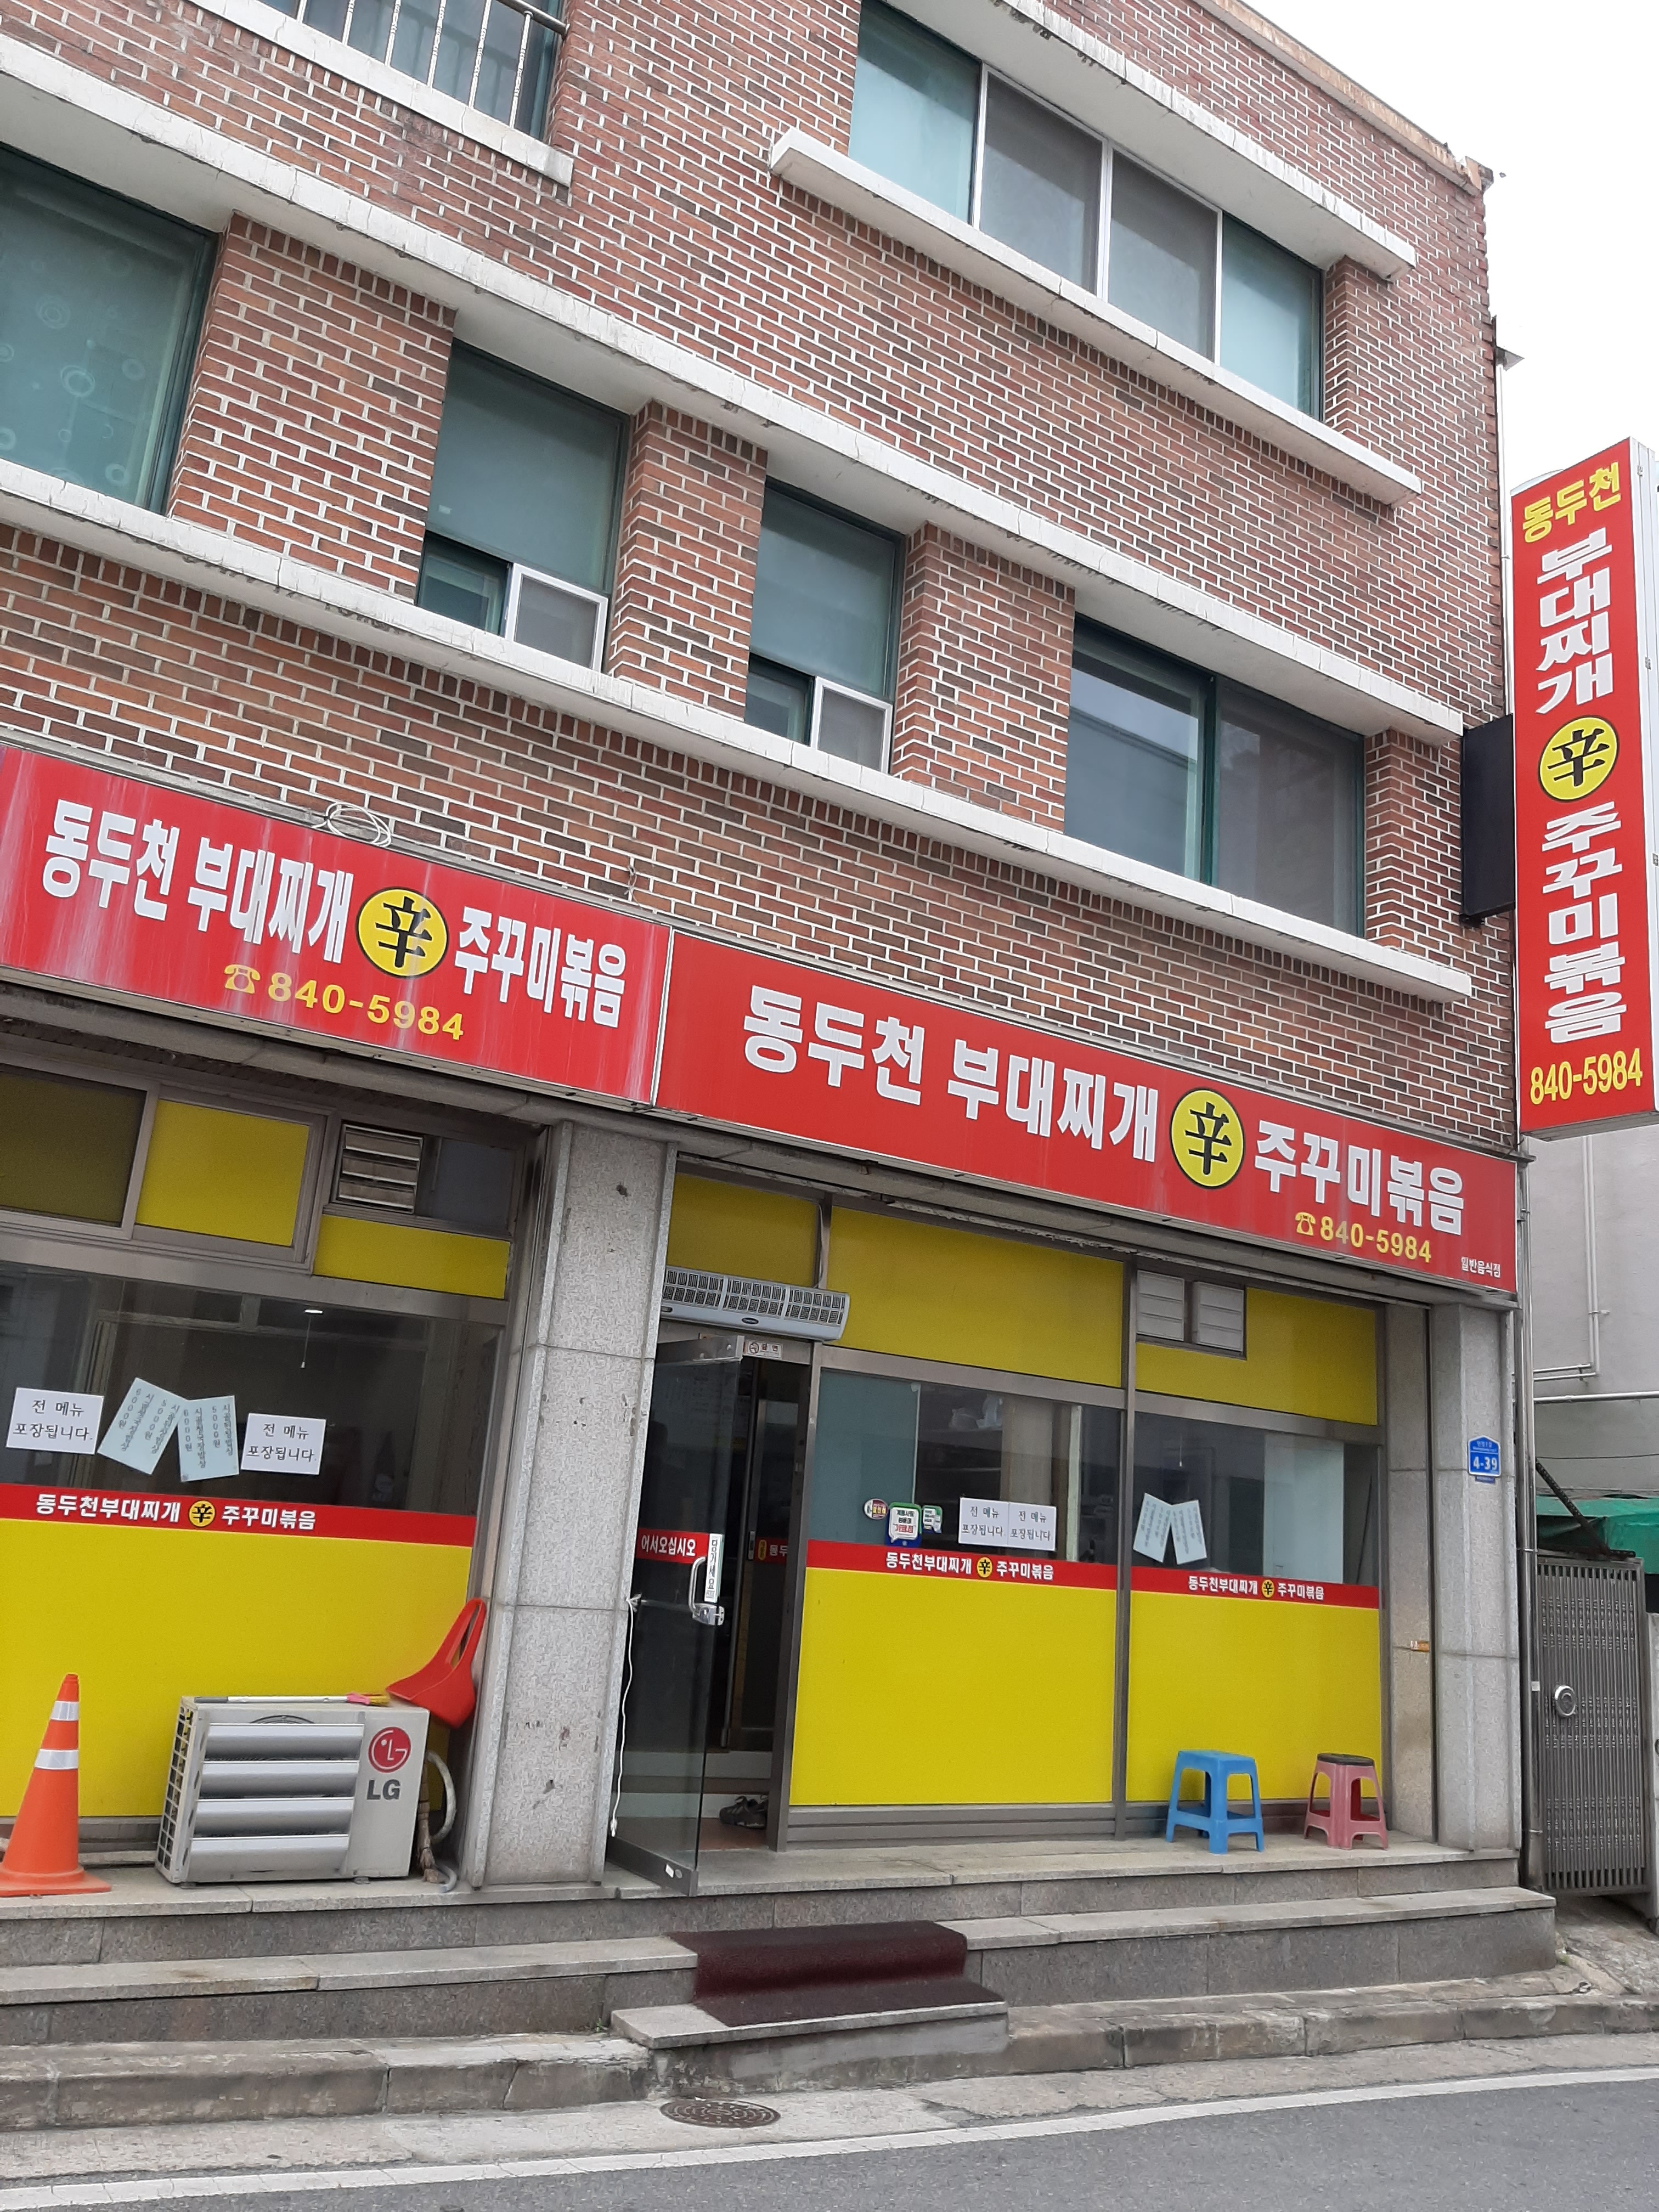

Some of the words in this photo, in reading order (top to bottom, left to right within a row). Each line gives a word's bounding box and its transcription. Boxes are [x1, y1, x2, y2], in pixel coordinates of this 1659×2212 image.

[1523, 461, 1622, 544] 동두천
[1536, 527, 1613, 715] 부대찌개
[43, 799, 179, 921] 동두천
[188, 836, 354, 964] 부대찌개
[454, 906, 627, 1028] 주꾸미볶음
[1541, 801, 1627, 1044] 주꾸미볶음
[268, 973, 465, 1041] 840-5984
[1530, 1047, 1643, 1105] 840-5984
[743, 985, 925, 1105] 동두천
[947, 1039, 1159, 1163] 부대찌개
[1254, 1120, 1464, 1236] 주꾸미볶음
[1319, 1216, 1431, 1262] 840-5984
[1461, 1257, 1500, 1278] 일반음식점
[32, 1399, 46, 1414] 전
[55, 1401, 84, 1418] 메뉴
[13, 1423, 93, 1441] 포장됩니다.
[263, 1423, 276, 1437] 전
[283, 1424, 309, 1438] 메뉴
[246, 1445, 317, 1463] 포장됩니다.
[1473, 1456, 1498, 1470] 4-39
[36, 1493, 181, 1523] 동두천부대찌개
[221, 1505, 317, 1531] 주꾸미볶음
[970, 1506, 978, 1517] 전
[983, 1507, 1000, 1519] 메뉴
[1018, 1510, 1026, 1522] 전
[1031, 1511, 1047, 1523] 메뉴
[641, 1534, 696, 1557] 어서오십시오
[885, 1551, 972, 1575] 동두천부대찌개
[996, 1561, 1054, 1581] 주꾸미볶음
[1188, 1575, 1258, 1595] 동두천부대찌개
[1277, 1582, 1324, 1601] 주꾸미볶음
[367, 1779, 401, 1800] LG
